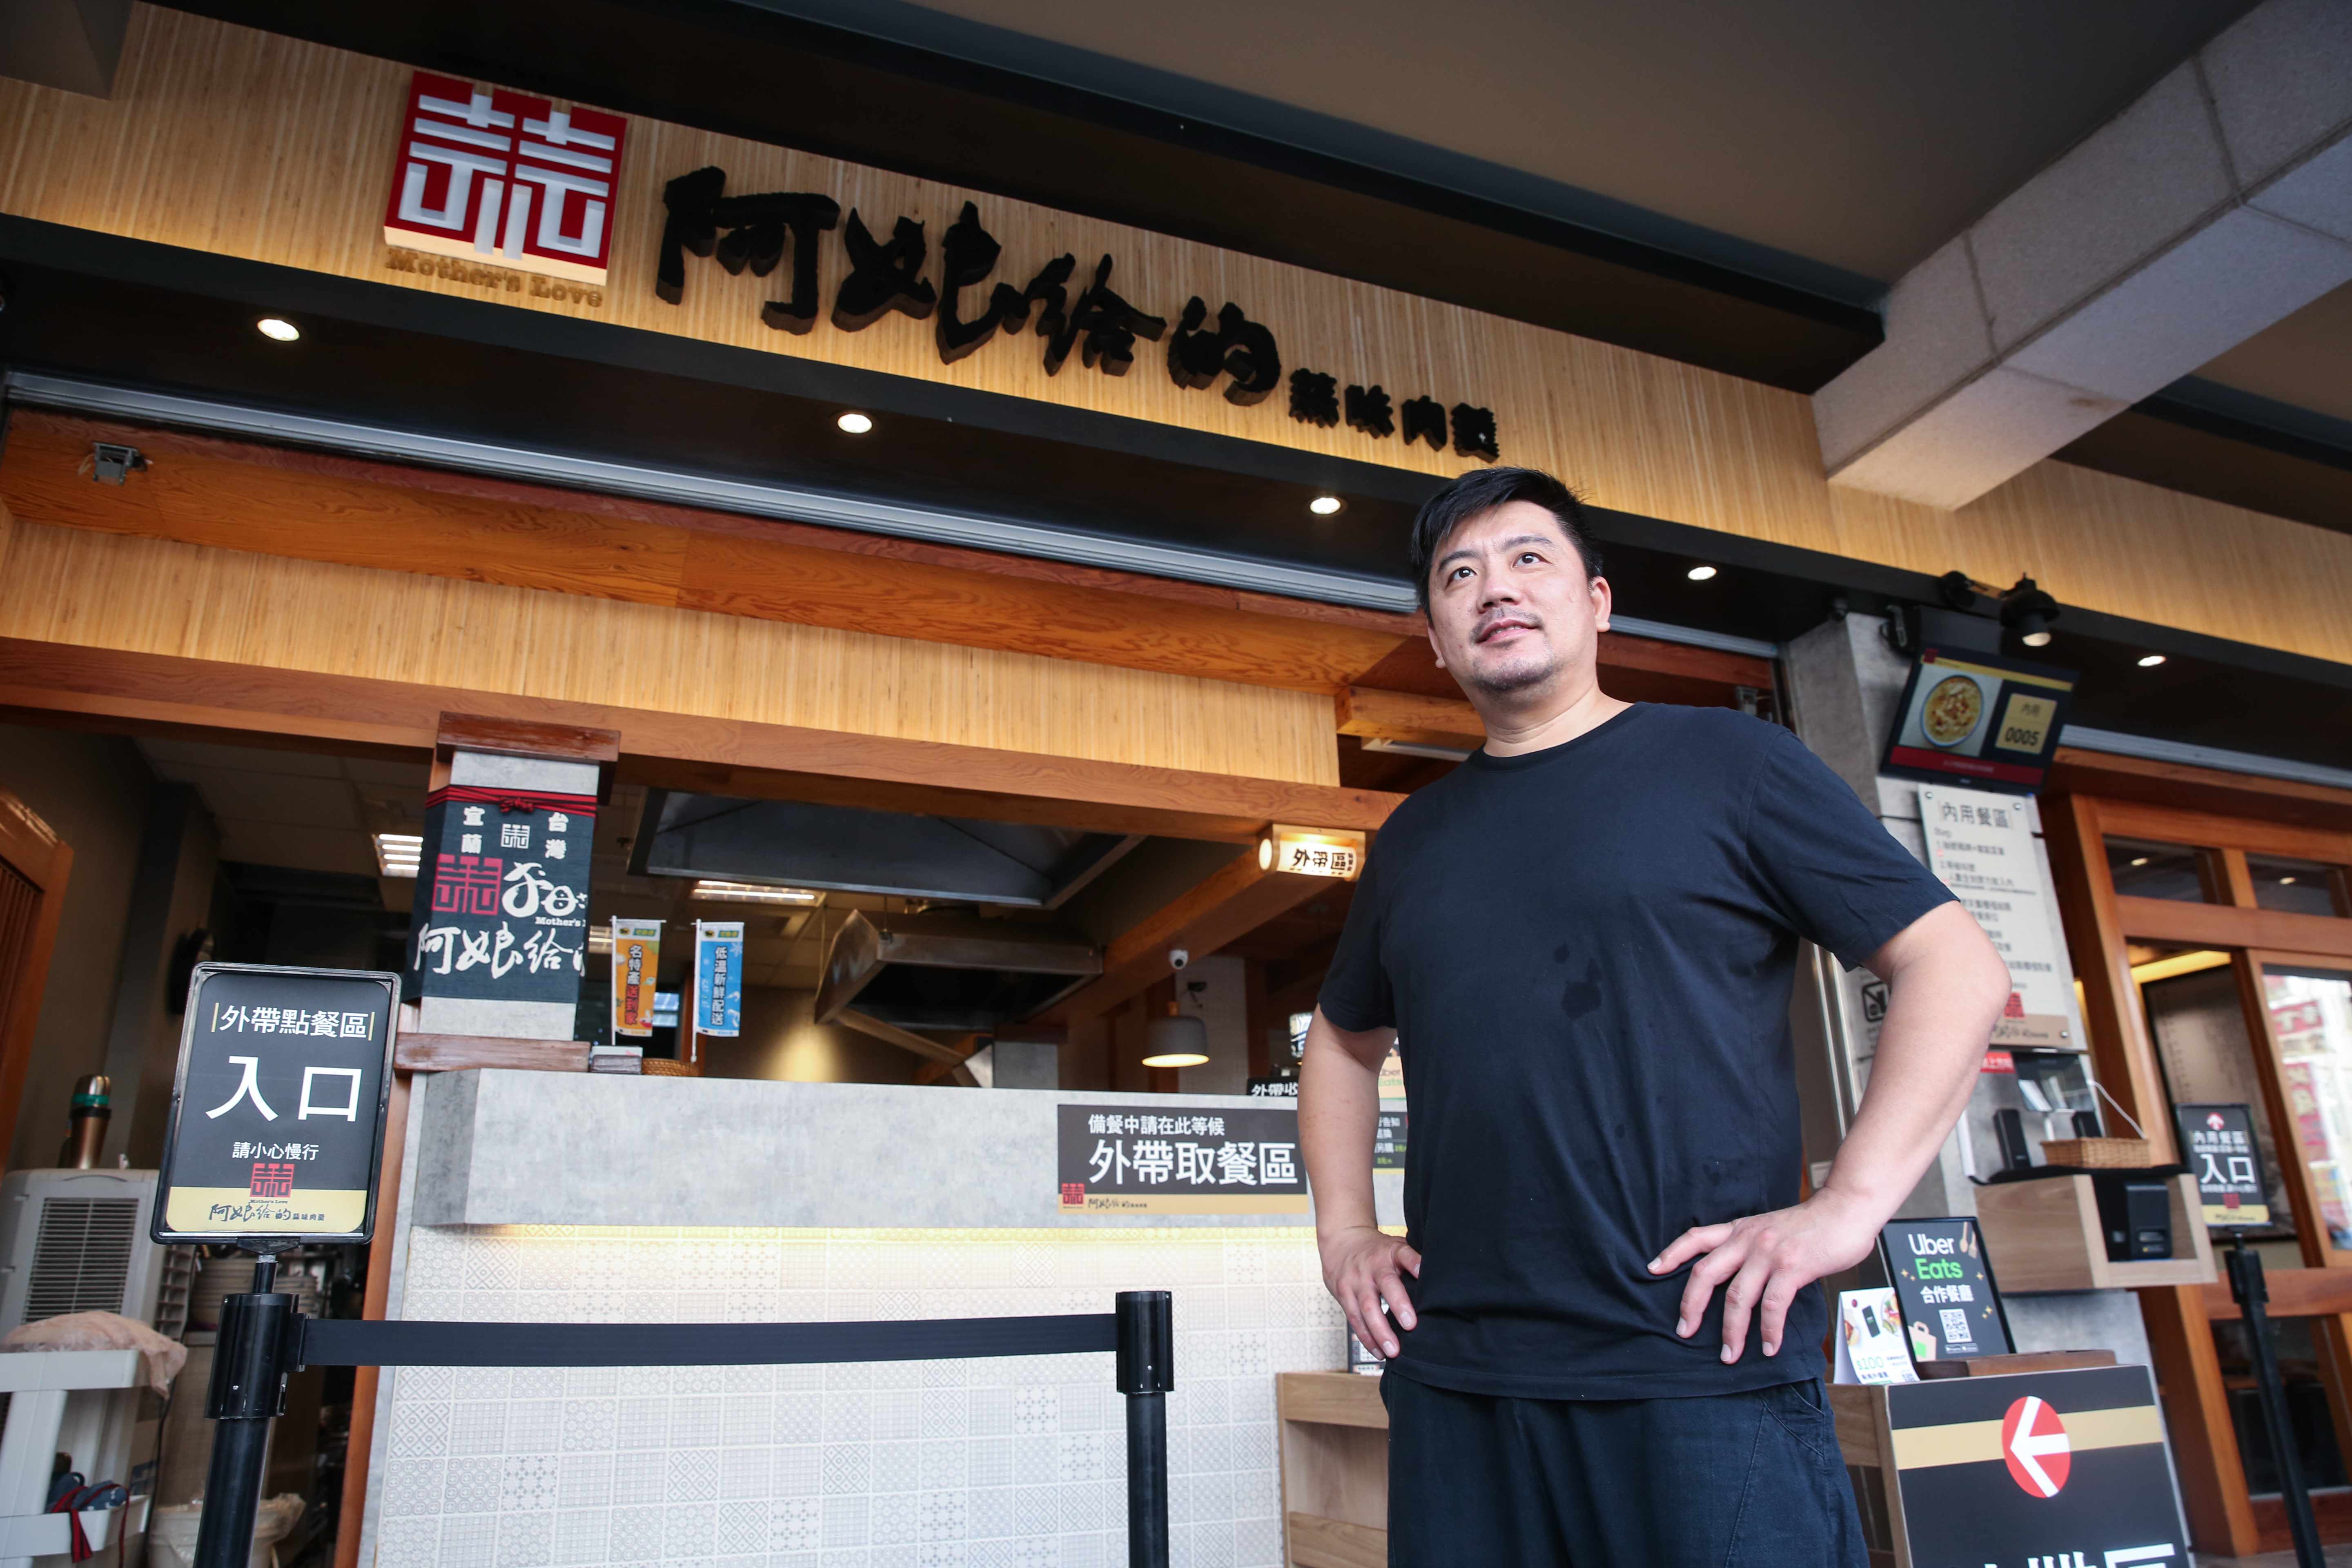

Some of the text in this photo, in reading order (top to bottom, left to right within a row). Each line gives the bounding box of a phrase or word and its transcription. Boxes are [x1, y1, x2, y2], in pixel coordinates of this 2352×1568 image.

[386, 247, 603, 307] Mother's Love
[2005, 727, 2040, 746] 0005
[461, 806, 486, 854] 宜蘭
[545, 812, 569, 860] 台灣
[1292, 848, 1345, 870] 外帶區
[535, 916, 581, 927] Mother's
[219, 1005, 369, 1038] 外帶點餐區
[205, 1056, 362, 1122] 入口
[1088, 1114, 1225, 1136] 備餐中請在此等候
[232, 1142, 319, 1161] 請小心慢行
[1089, 1140, 1298, 1186] 外帶取餐區
[2199, 1154, 2256, 1183] 入口
[1907, 1233, 1955, 1256] Uber
[1915, 1258, 1964, 1280] Eats
[1920, 1284, 1975, 1304] 合作餐廳
[1856, 1356, 1884, 1370] $100
